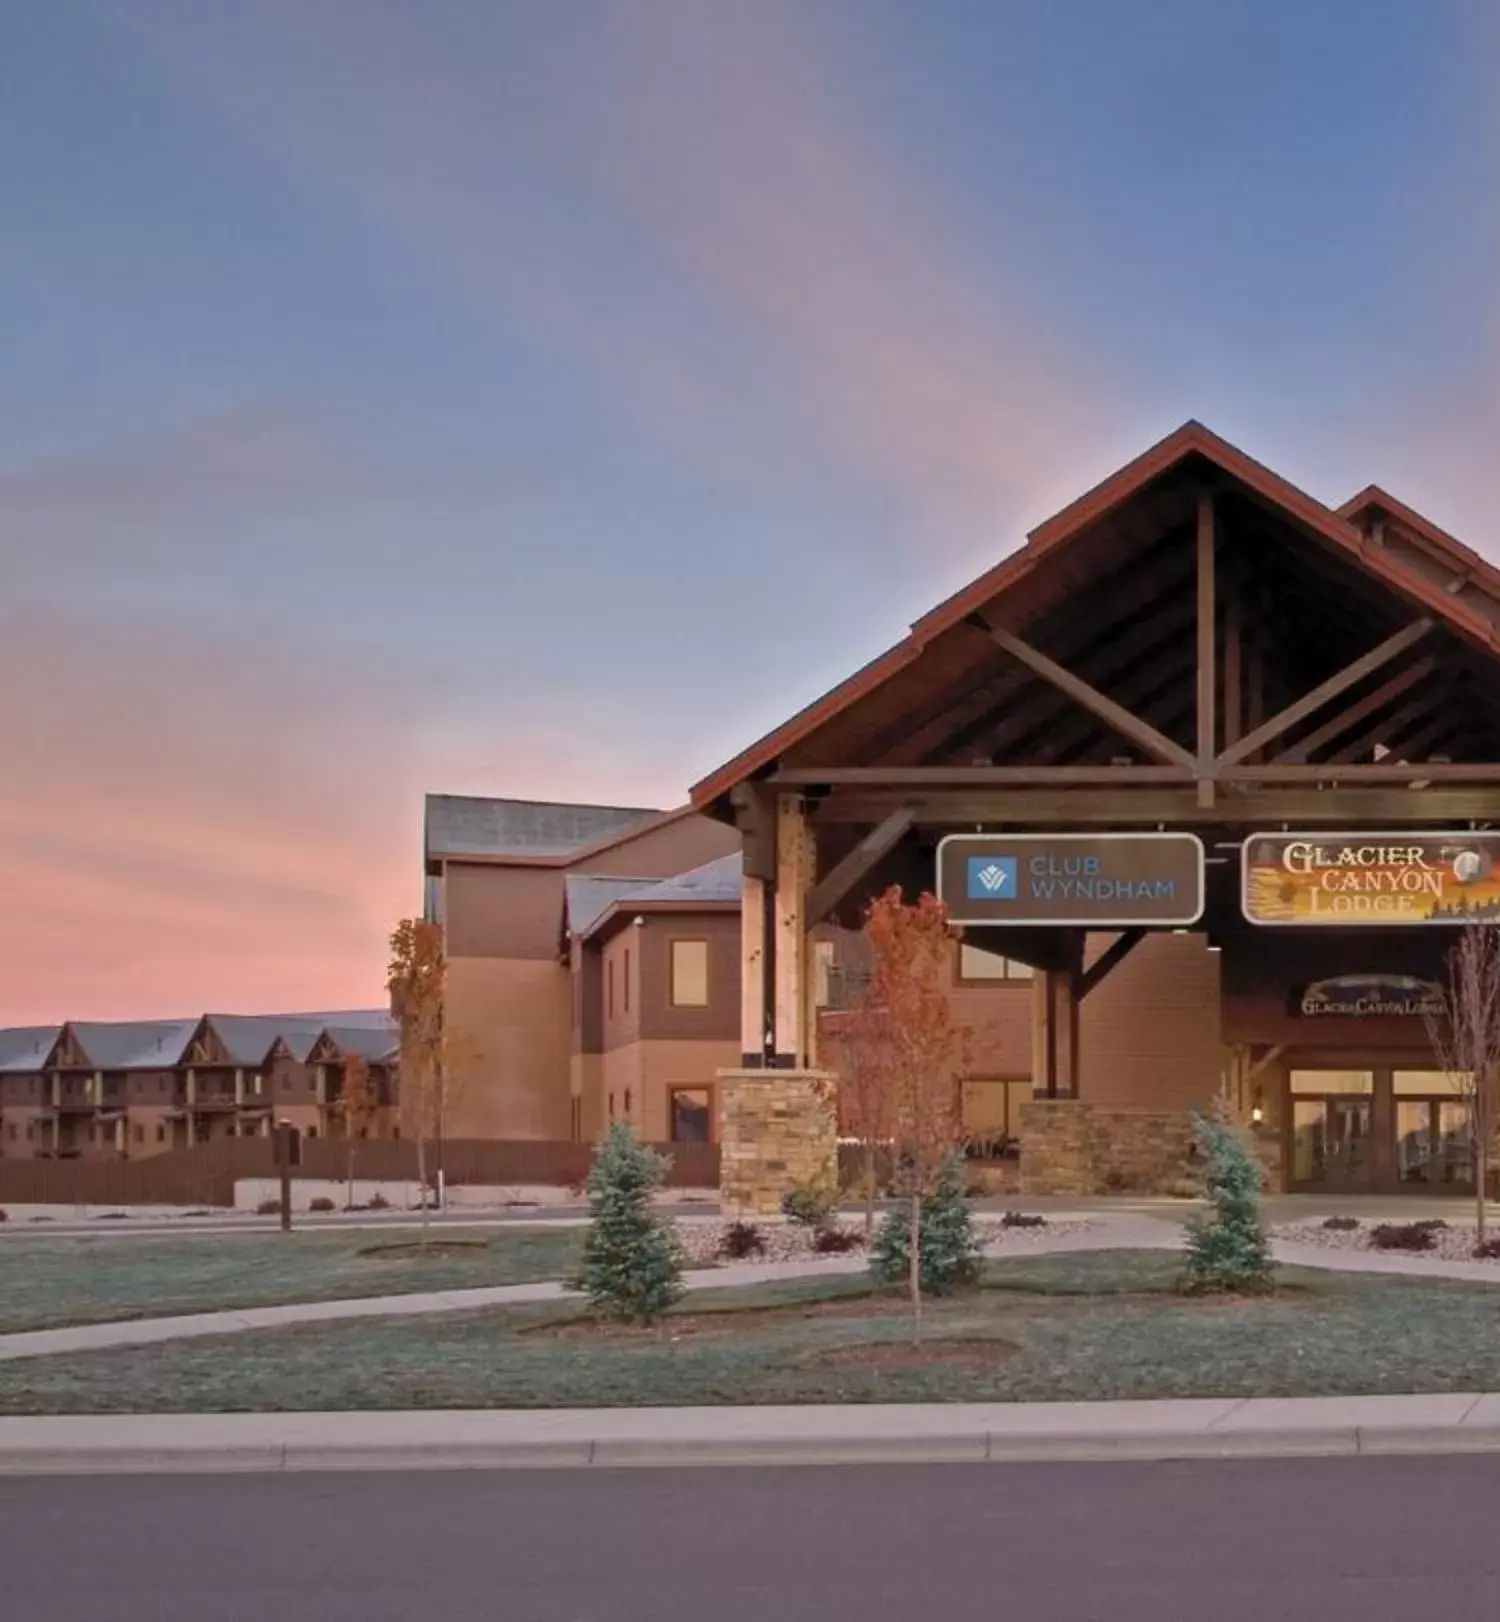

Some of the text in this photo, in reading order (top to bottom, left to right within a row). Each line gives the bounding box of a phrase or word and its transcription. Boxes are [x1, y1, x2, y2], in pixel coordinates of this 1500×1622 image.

[1030, 856, 1100, 876] CLUB
[1282, 842, 1436, 874] GLACIER
[1030, 880, 1174, 899] WYNDHAM
[1321, 867, 1445, 897] CANYON
[1308, 886, 1415, 914] LODGE
